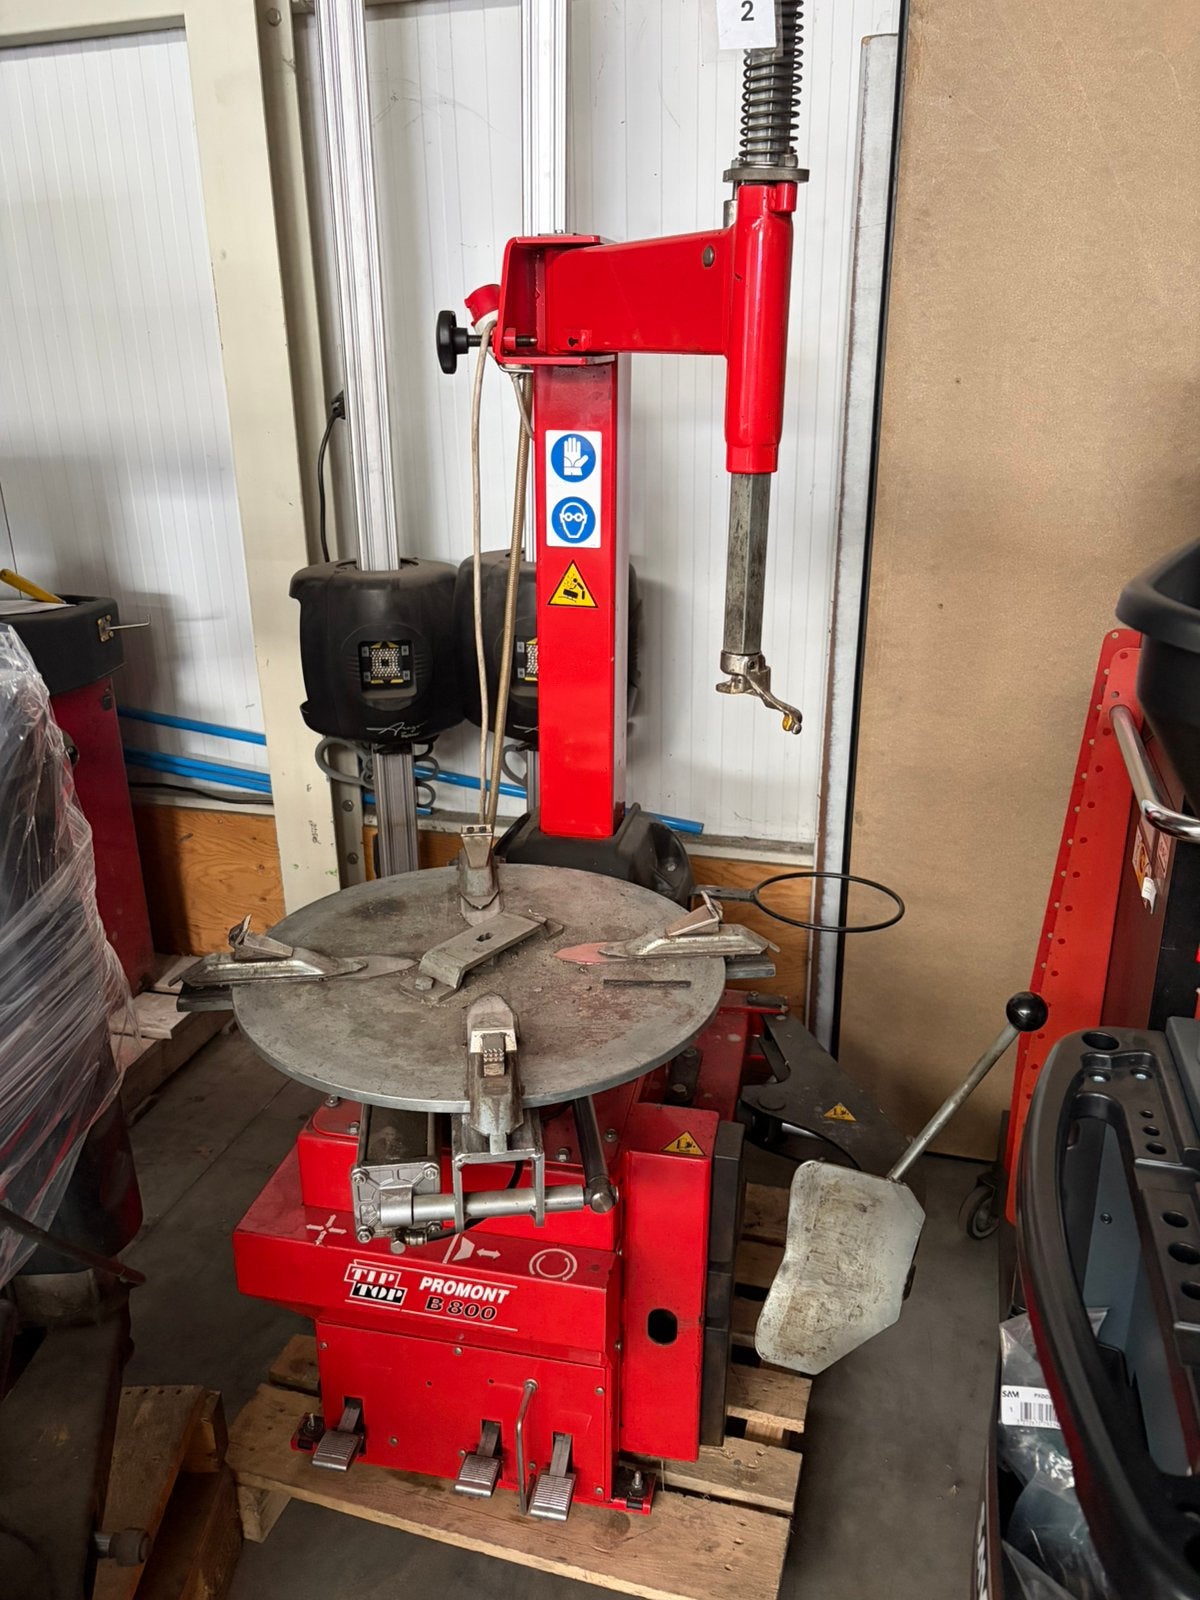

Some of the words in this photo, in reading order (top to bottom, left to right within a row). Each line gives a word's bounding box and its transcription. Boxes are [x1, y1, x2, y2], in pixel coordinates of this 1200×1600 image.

[741, 0, 754, 21] 2
[351, 1267, 395, 1285] TIP
[356, 1283, 403, 1301] TOP
[419, 1276, 509, 1304] PROMONT
[425, 1295, 443, 1312] B
[447, 1300, 497, 1321] 800
